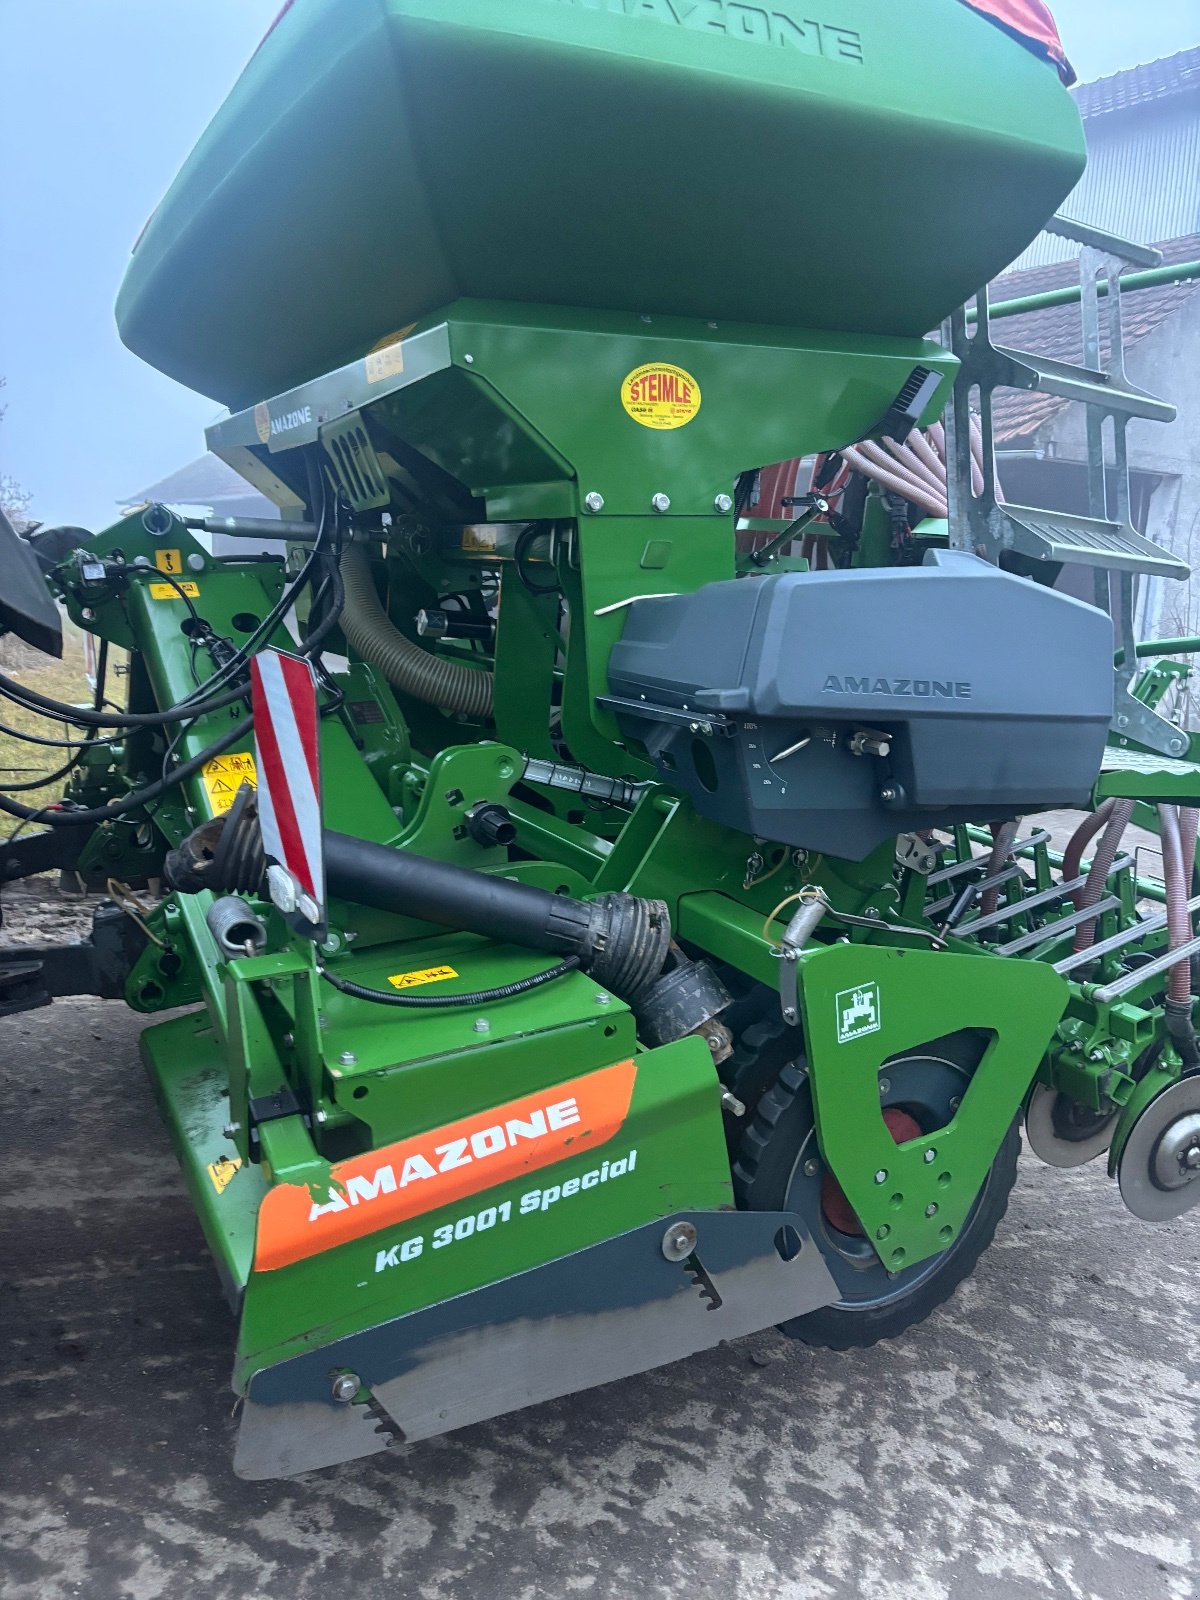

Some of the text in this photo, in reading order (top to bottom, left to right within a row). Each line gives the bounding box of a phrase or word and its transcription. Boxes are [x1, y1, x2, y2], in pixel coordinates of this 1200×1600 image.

[630, 373, 692, 404] STEIMLE
[271, 405, 312, 435] AMAZONE
[820, 675, 972, 699] AMAZONE
[308, 1097, 581, 1222] AMAZONE
[374, 1149, 638, 1273] KG 3001 Special
